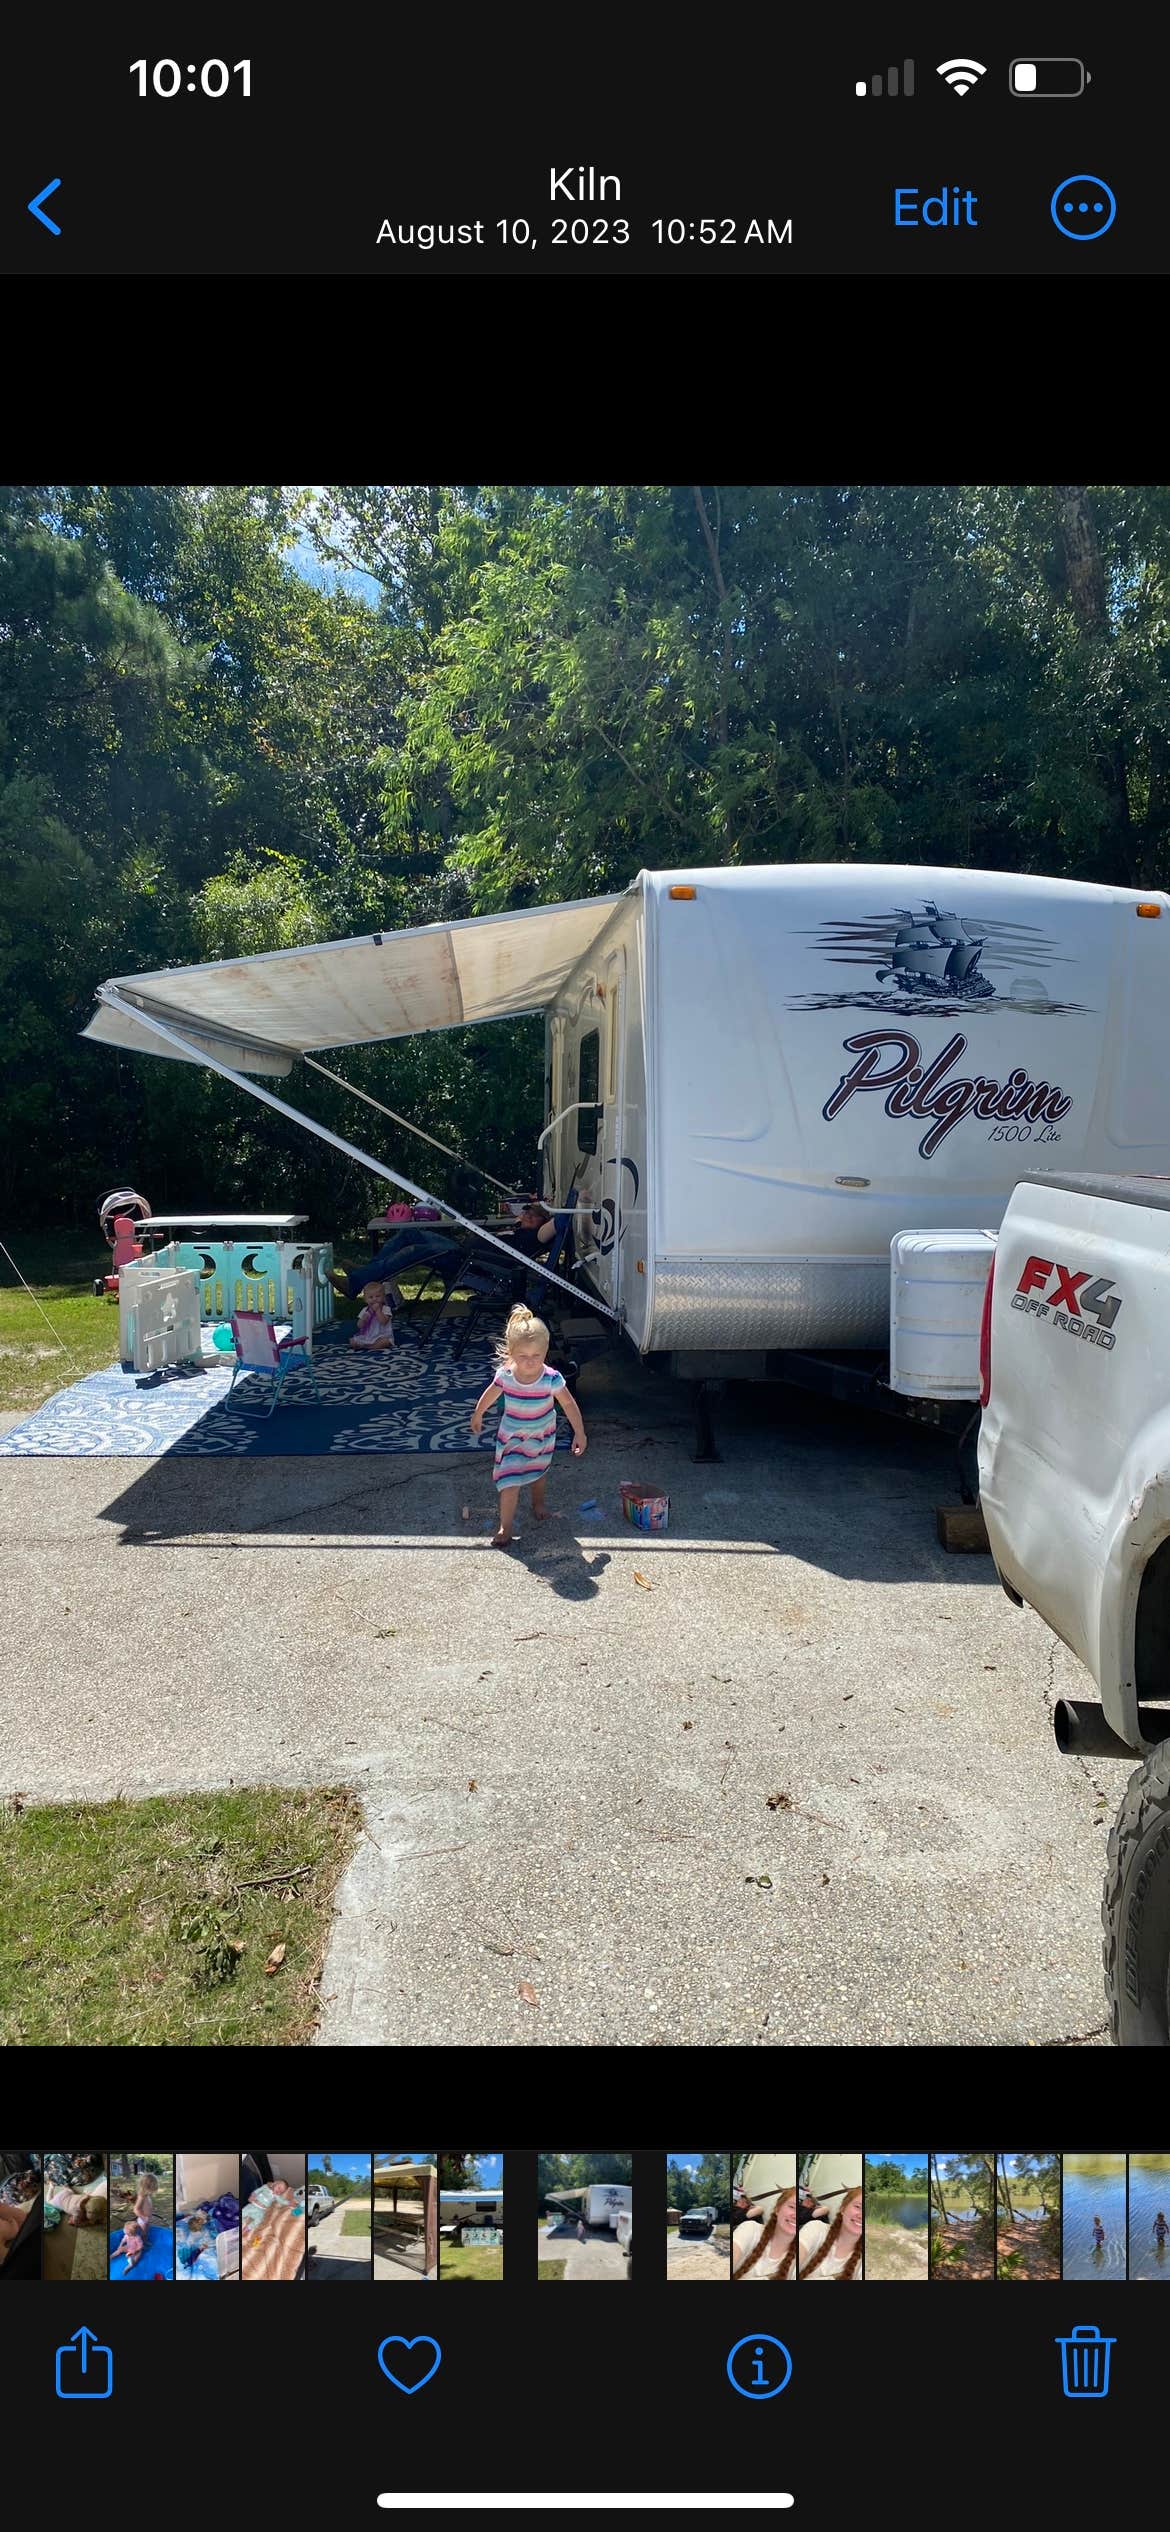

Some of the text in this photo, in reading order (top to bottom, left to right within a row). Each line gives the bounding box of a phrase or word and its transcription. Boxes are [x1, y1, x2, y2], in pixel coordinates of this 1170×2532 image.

[822, 1028, 1073, 1160] Pilgrim
[987, 1124, 1062, 1144] 1500 Lite
[1010, 1293, 1117, 1351] OFF ROAD
[1016, 1255, 1122, 1329] FX4
